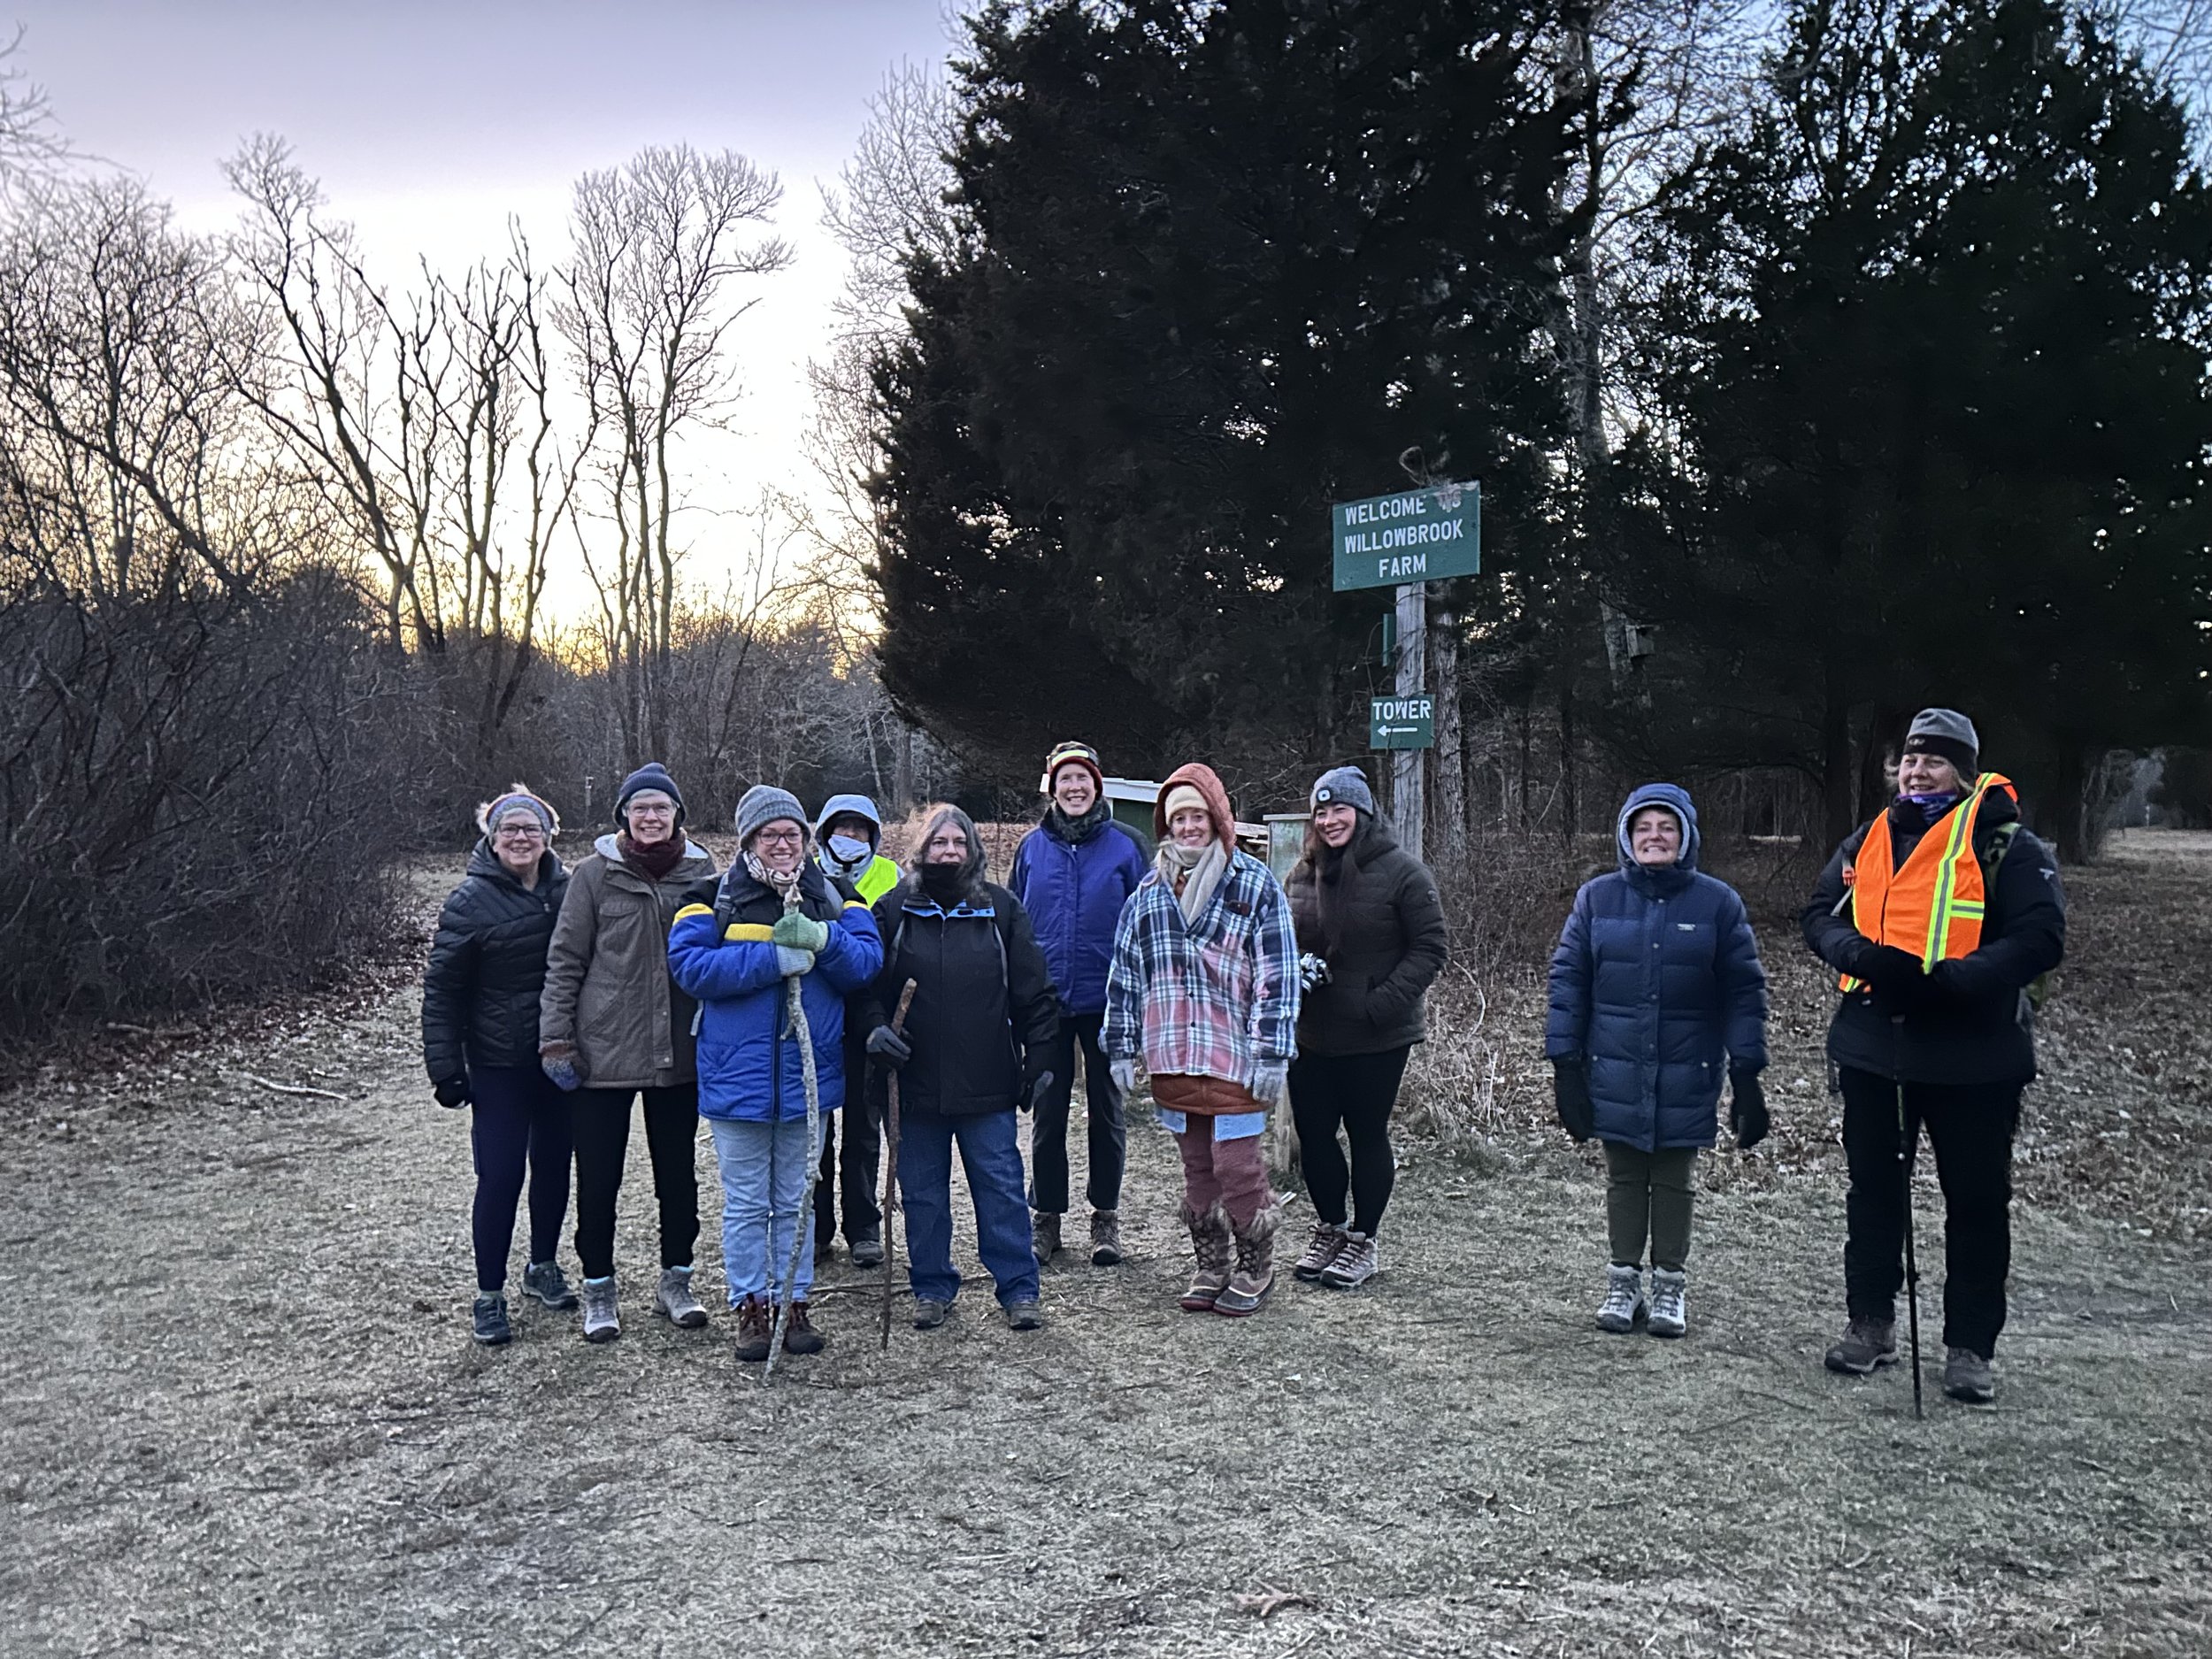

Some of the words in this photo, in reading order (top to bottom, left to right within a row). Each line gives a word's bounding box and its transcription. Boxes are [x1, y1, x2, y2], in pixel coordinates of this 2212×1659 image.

[1345, 497, 1426, 526] WELCOME
[1344, 518, 1463, 554] WILLOWBROOK
[1379, 554, 1426, 578] FARM
[1372, 699, 1432, 720] TOWER
